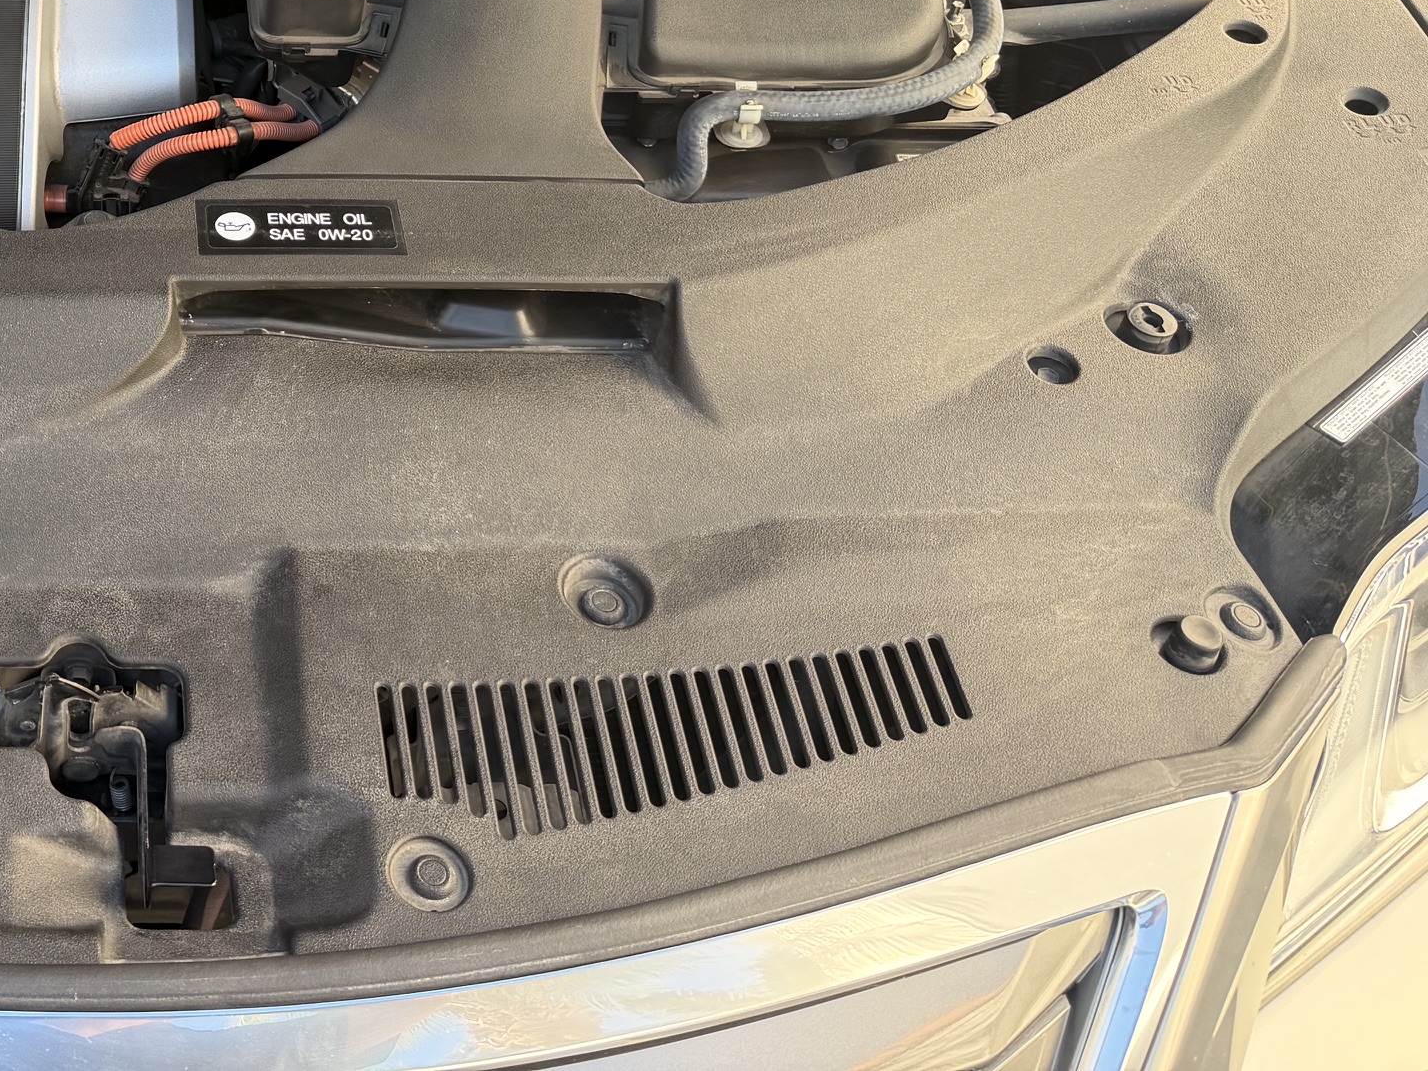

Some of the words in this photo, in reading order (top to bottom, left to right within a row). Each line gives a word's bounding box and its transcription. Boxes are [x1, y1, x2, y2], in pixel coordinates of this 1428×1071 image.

[267, 212, 332, 225] ENGINE
[342, 212, 373, 226] OIL
[269, 228, 306, 241] SAE
[318, 228, 374, 241] 0W-20
